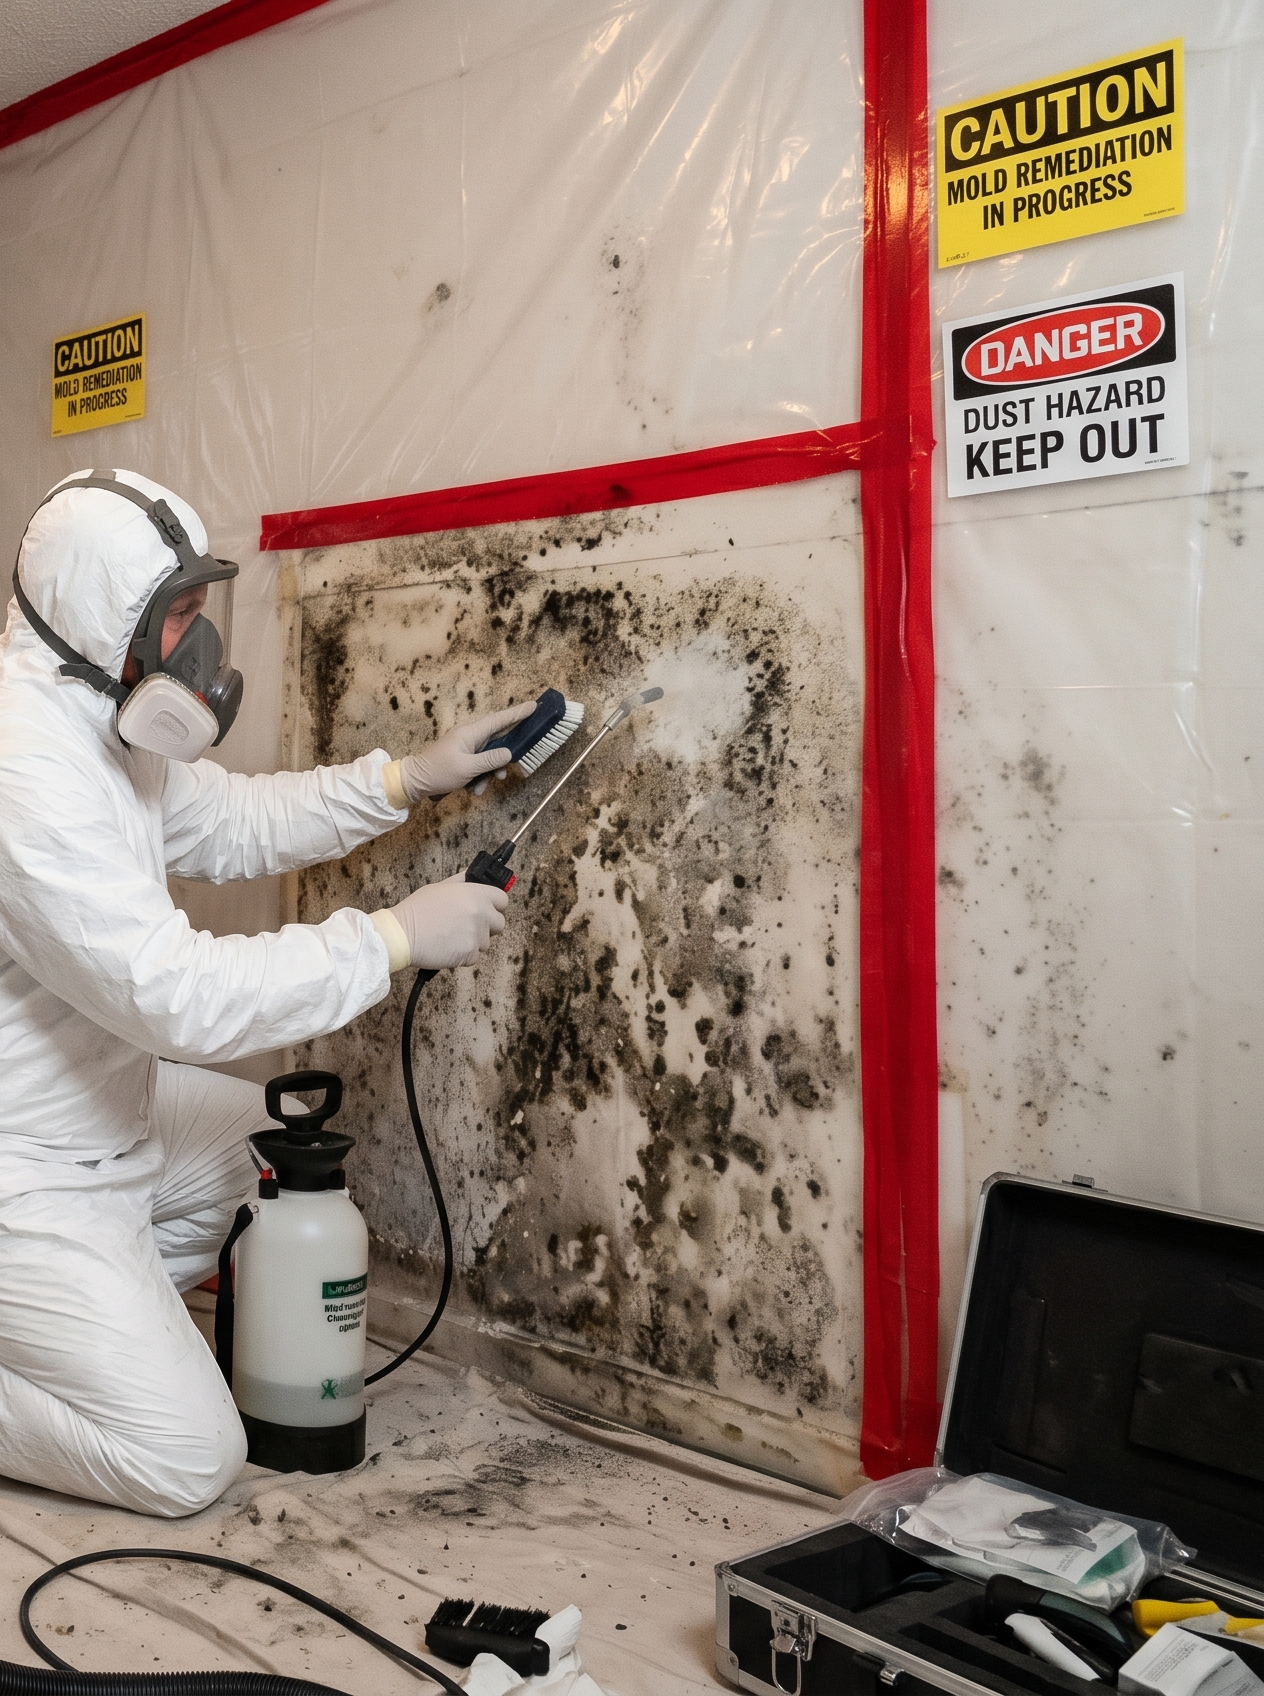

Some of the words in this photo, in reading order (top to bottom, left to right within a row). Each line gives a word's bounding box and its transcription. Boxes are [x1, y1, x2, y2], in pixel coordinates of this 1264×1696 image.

[949, 60, 1167, 161] CAUTION
[947, 167, 1008, 206] MOLD
[1016, 124, 1172, 187] REMEDIATION
[983, 204, 1004, 230] IN
[1013, 171, 1133, 223] PROGRESS
[57, 325, 139, 372] CAUTION
[980, 312, 1144, 377] DANGER
[54, 378, 80, 400] MOLD
[82, 362, 142, 393] REMEDIATION
[67, 399, 77, 418] IN
[79, 387, 127, 415] PROGRESS
[964, 397, 1035, 434] DUST
[1046, 375, 1166, 421] HAZARD
[966, 429, 1064, 480] KEEP
[1079, 414, 1165, 464] OUT
